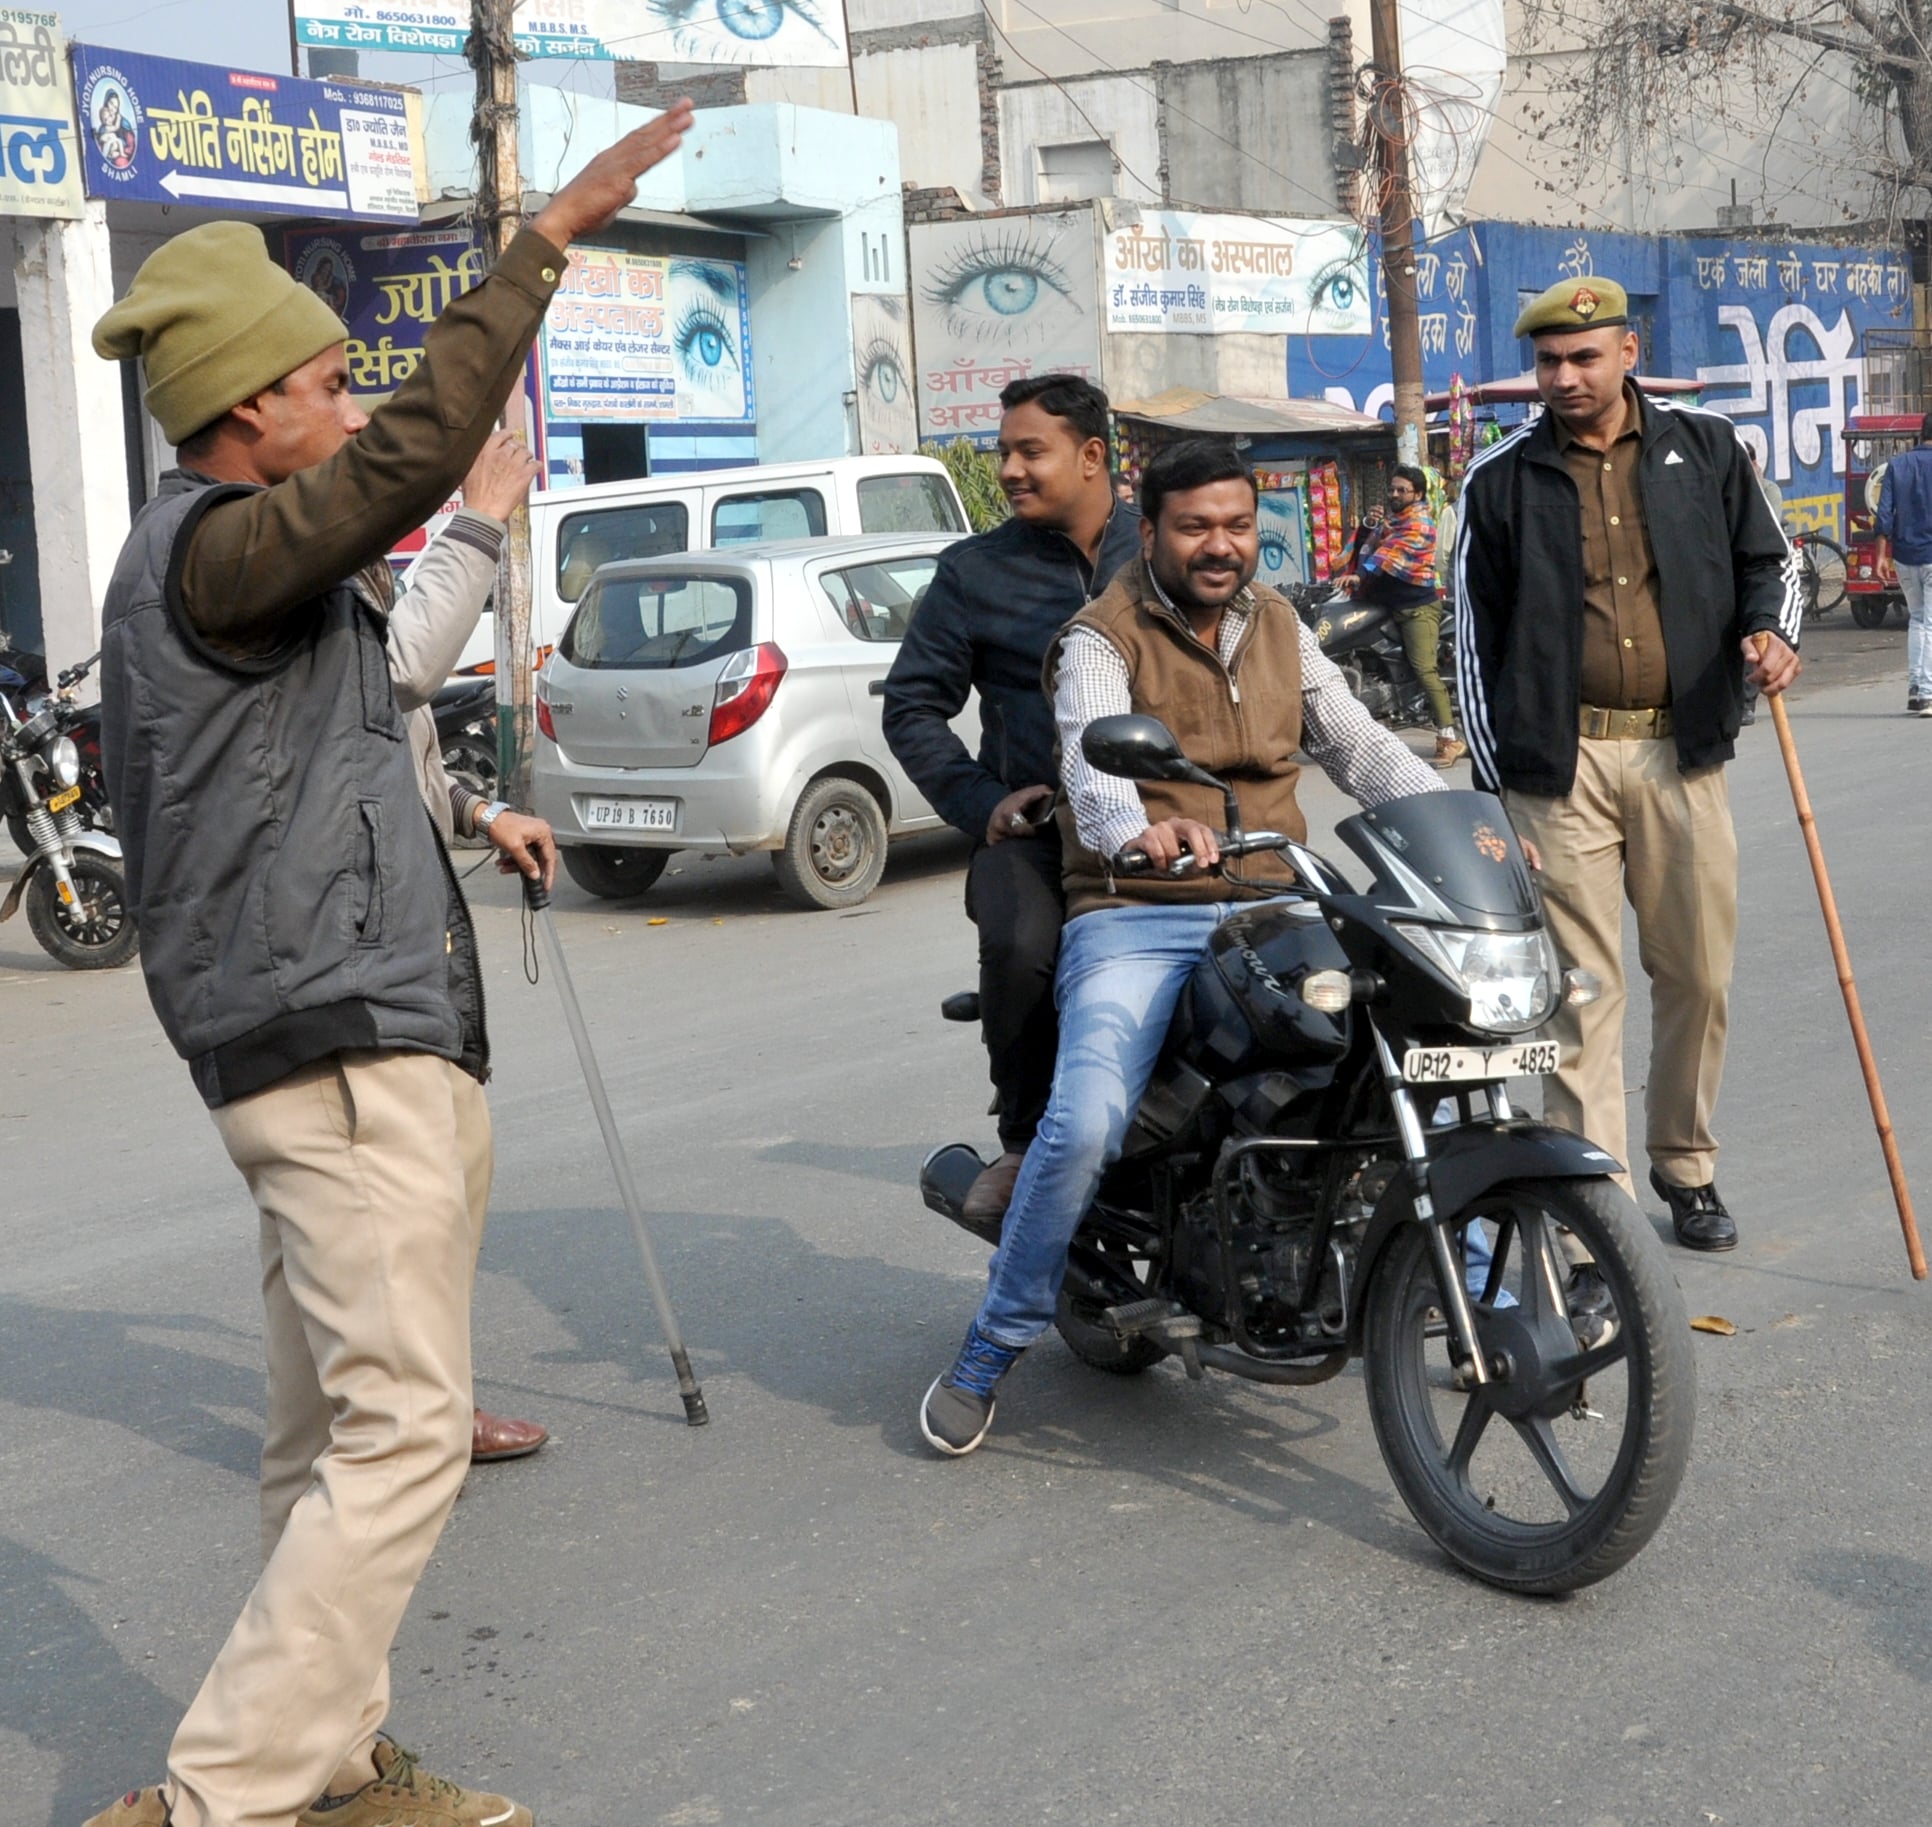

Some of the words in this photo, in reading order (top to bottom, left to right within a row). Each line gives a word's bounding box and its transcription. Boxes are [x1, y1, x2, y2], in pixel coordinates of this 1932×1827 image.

[306, 20, 340, 40] नेत्र
[345, 21, 381, 43] रोग
[386, 24, 456, 49] विशेषज्ञ
[376, 11, 456, 26] 8650631800
[81, 82, 93, 117] JYOTI
[88, 65, 128, 88] NURSING
[127, 87, 145, 124] HOME
[353, 91, 404, 111] 9368117025
[146, 89, 223, 170] ज्योति
[223, 96, 297, 177] नर्सिंग
[297, 107, 344, 187] होम
[101, 164, 138, 182] SHAMLI
[1115, 223, 1172, 273] आँखो
[1176, 237, 1206, 272] का
[1210, 239, 1294, 277] अस्पताल
[626, 268, 664, 300] का
[1734, 255, 1772, 290] जला
[1129, 282, 1159, 308] संजीव
[1160, 286, 1187, 315] कुमार
[1187, 283, 1206, 310] सिंह
[550, 301, 665, 339] अस्पताल
[1196, 313, 1207, 325] MS
[1317, 620, 1334, 642] 200
[628, 807, 636, 825] B
[643, 808, 673, 826] 7650
[1482, 1051, 1494, 1077] Y
[1518, 1045, 1556, 1076] 4825
